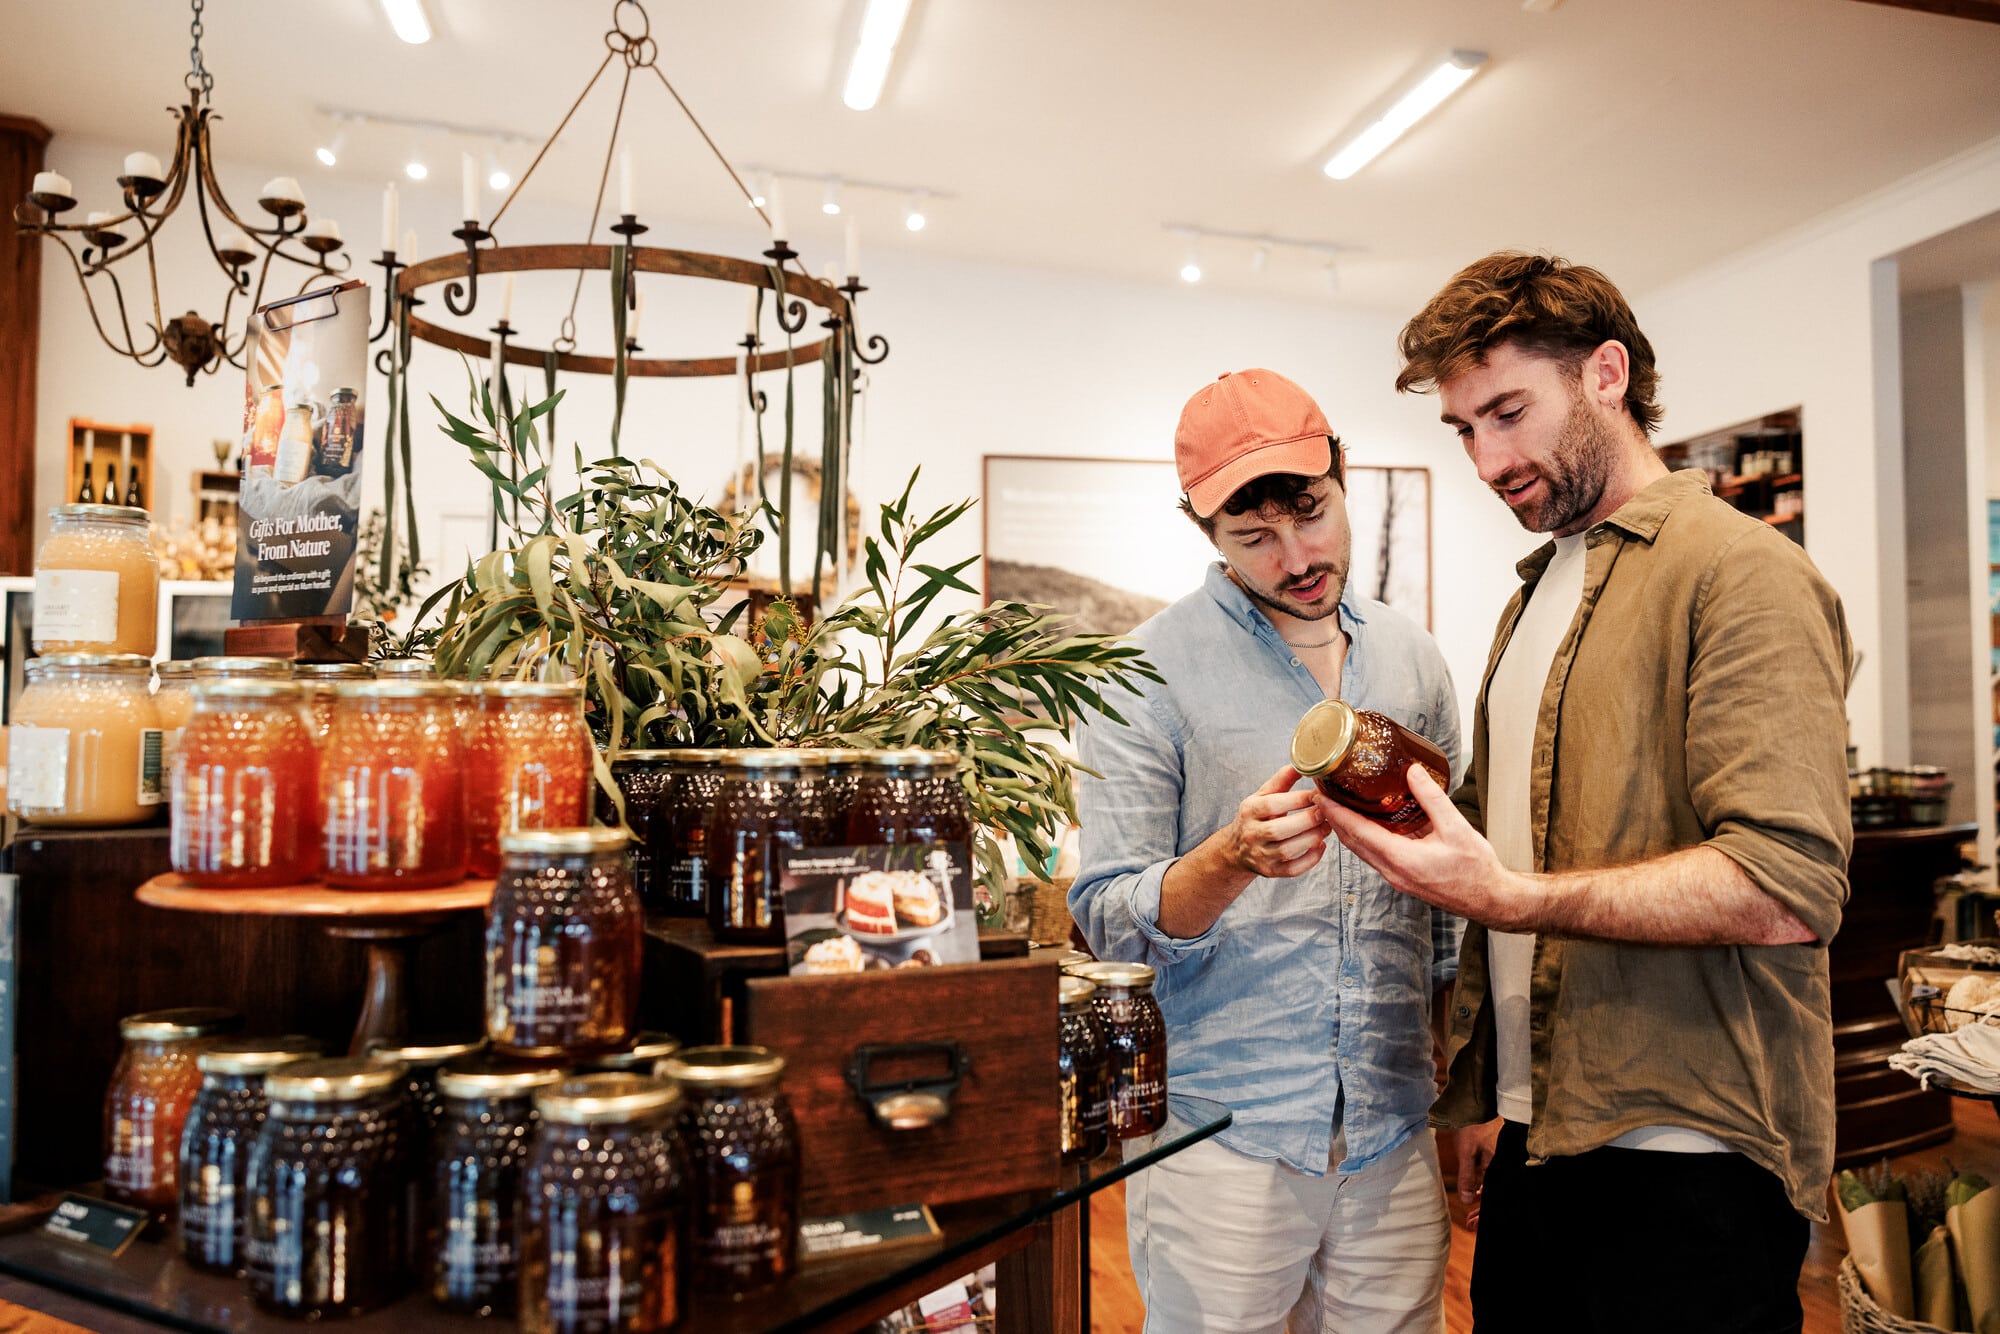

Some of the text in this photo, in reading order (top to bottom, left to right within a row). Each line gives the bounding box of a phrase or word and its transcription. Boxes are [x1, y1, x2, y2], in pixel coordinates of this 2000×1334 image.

[249, 511, 343, 541] Gifts For Mother,
[257, 539, 331, 561] From Nature
[278, 572, 286, 581] the
[306, 570, 318, 579] with
[268, 584, 277, 592] and
[278, 582, 294, 593] special
